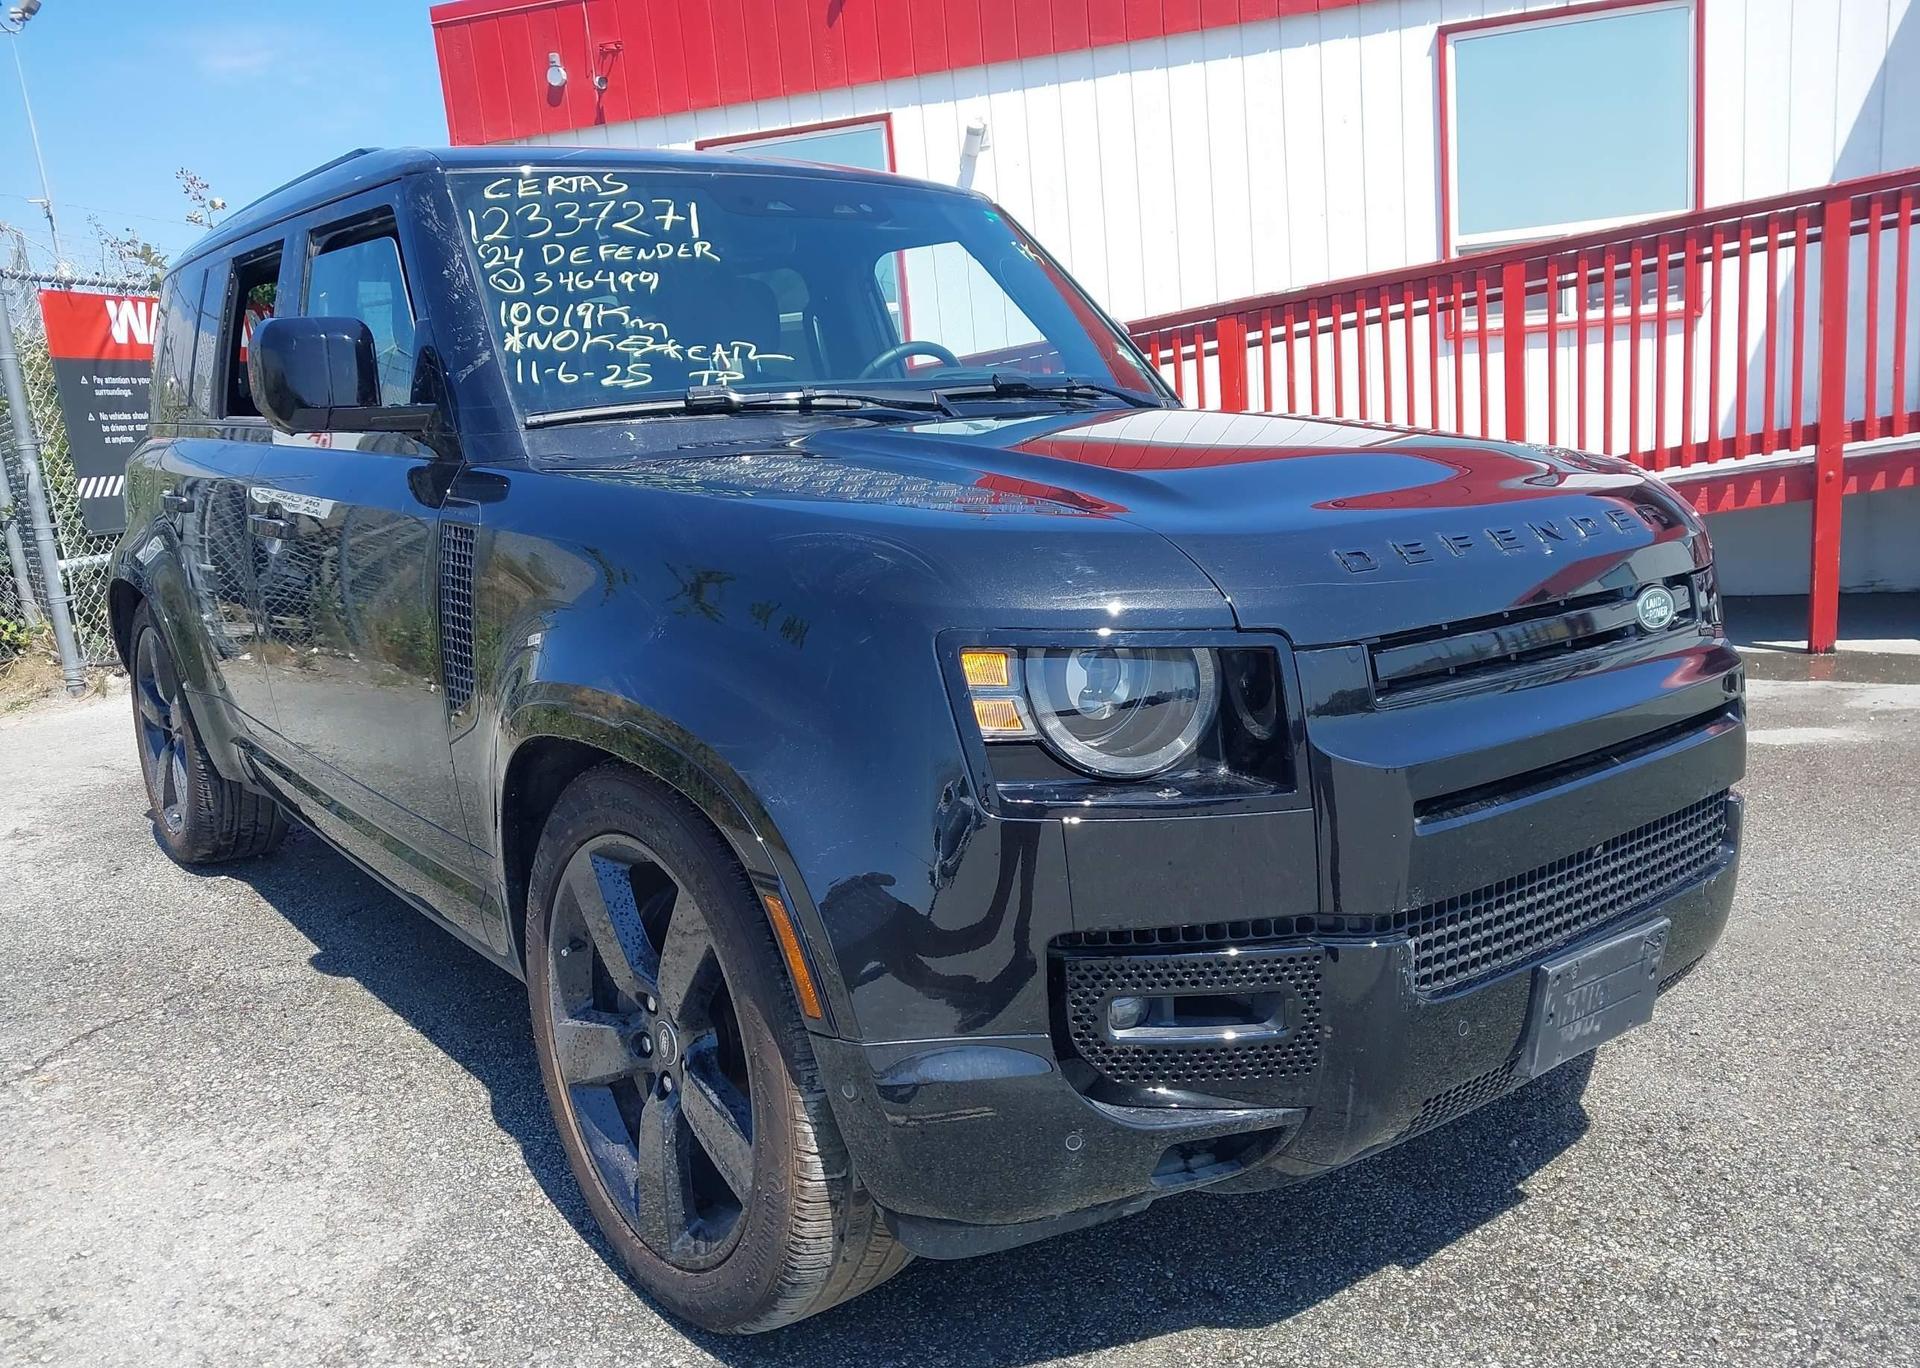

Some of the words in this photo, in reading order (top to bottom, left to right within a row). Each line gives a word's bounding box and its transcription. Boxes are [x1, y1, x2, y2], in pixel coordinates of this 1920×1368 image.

[541, 241, 721, 266] DEFENDER
[516, 359, 653, 389] 11-6-25
[93, 375, 103, 386] Pay
[104, 376, 130, 385] attention
[130, 376, 137, 385] to
[94, 387, 134, 398] surroundings.
[99, 411, 109, 421] No
[109, 411, 132, 421] vehicles
[101, 424, 110, 432] be
[110, 423, 127, 432] driven
[104, 436, 111, 444] at
[1332, 504, 1673, 574] DEFENDER
[1645, 596, 1662, 610] LAND
[1648, 605, 1668, 620] ROVER
